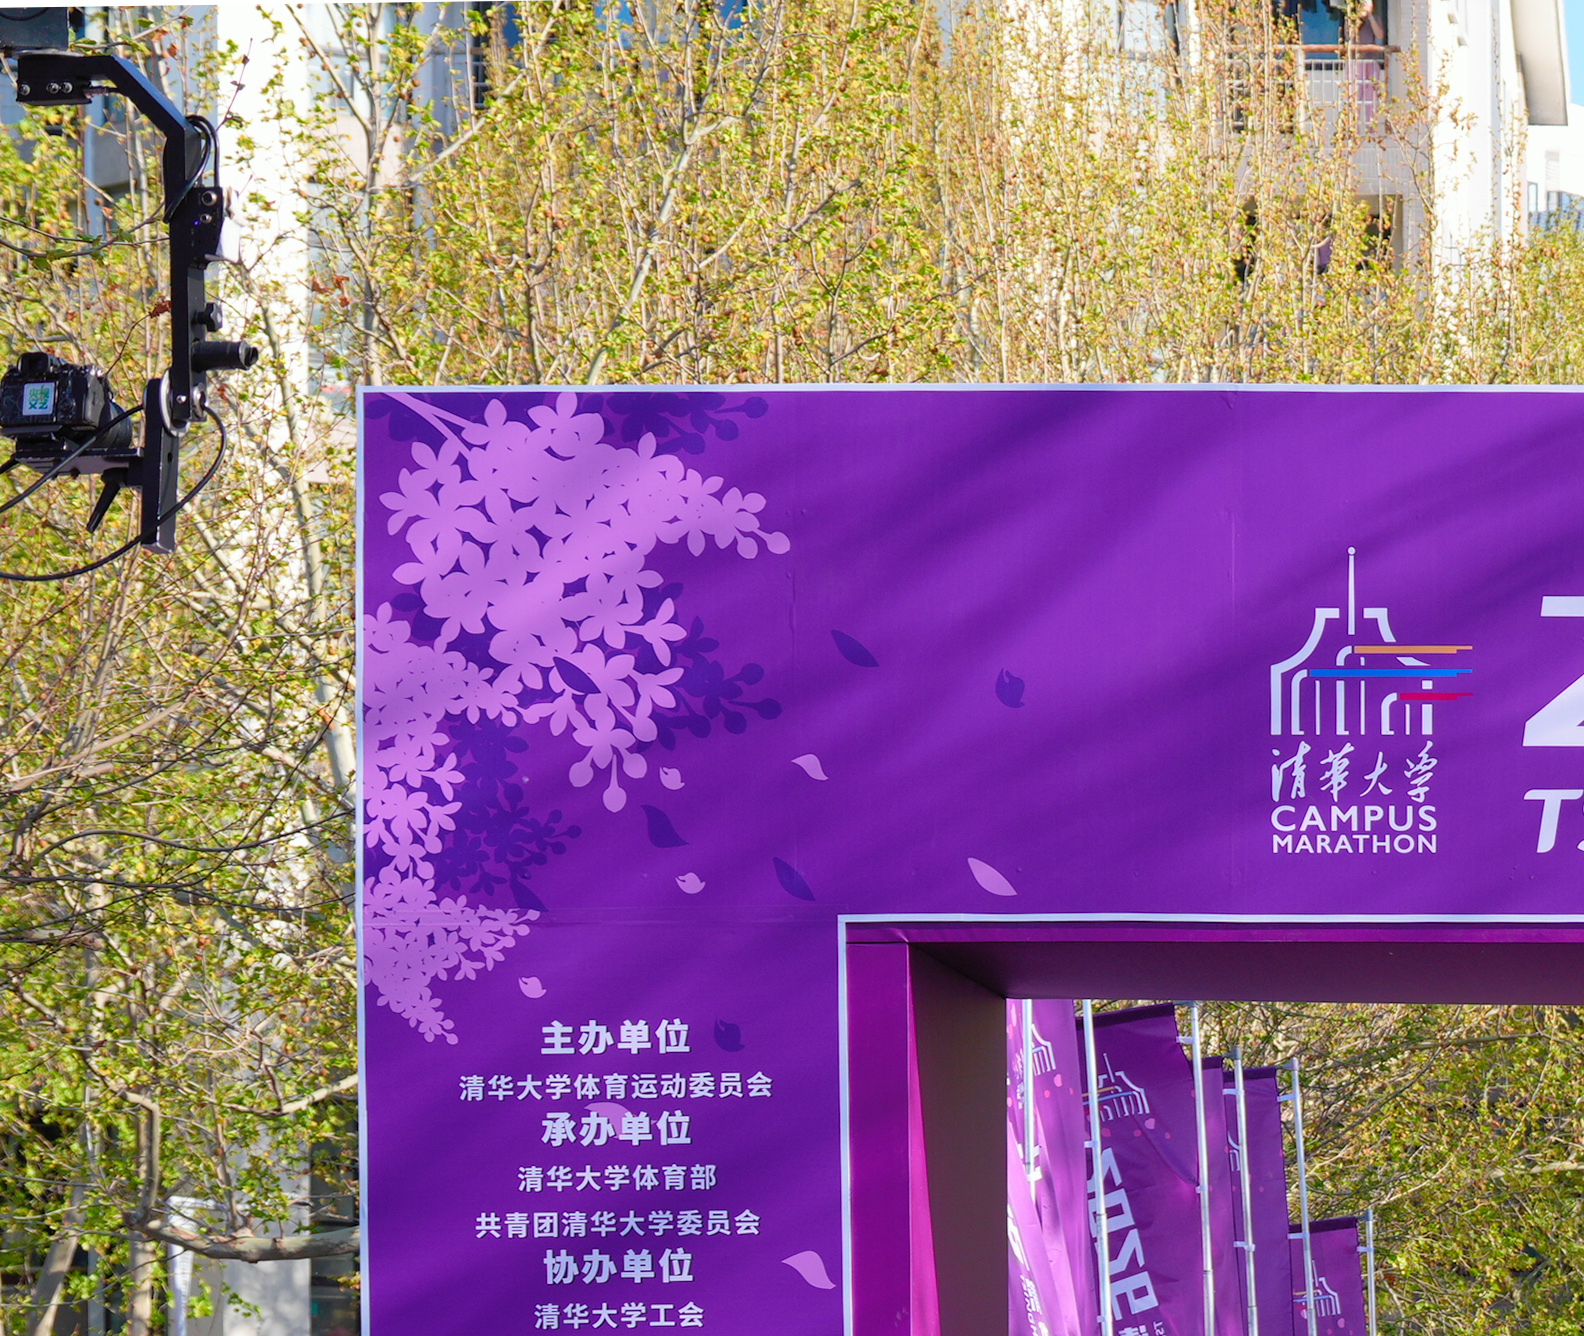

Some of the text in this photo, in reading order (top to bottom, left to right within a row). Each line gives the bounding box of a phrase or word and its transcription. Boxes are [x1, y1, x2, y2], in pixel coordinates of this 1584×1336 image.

[1271, 806, 1438, 832] CAMPUS
[1272, 834, 1437, 854] MARATHON
[541, 1018, 690, 1054] 主办单位
[458, 1072, 773, 1101] 清华大学体育运动委员会
[541, 1110, 691, 1147] 承办单位
[517, 1164, 717, 1193] 清华大学体育部
[475, 1209, 760, 1239] 共青团清华大学委员会
[543, 1247, 693, 1285] 协办单位
[534, 1301, 705, 1330] 清华大学工会
